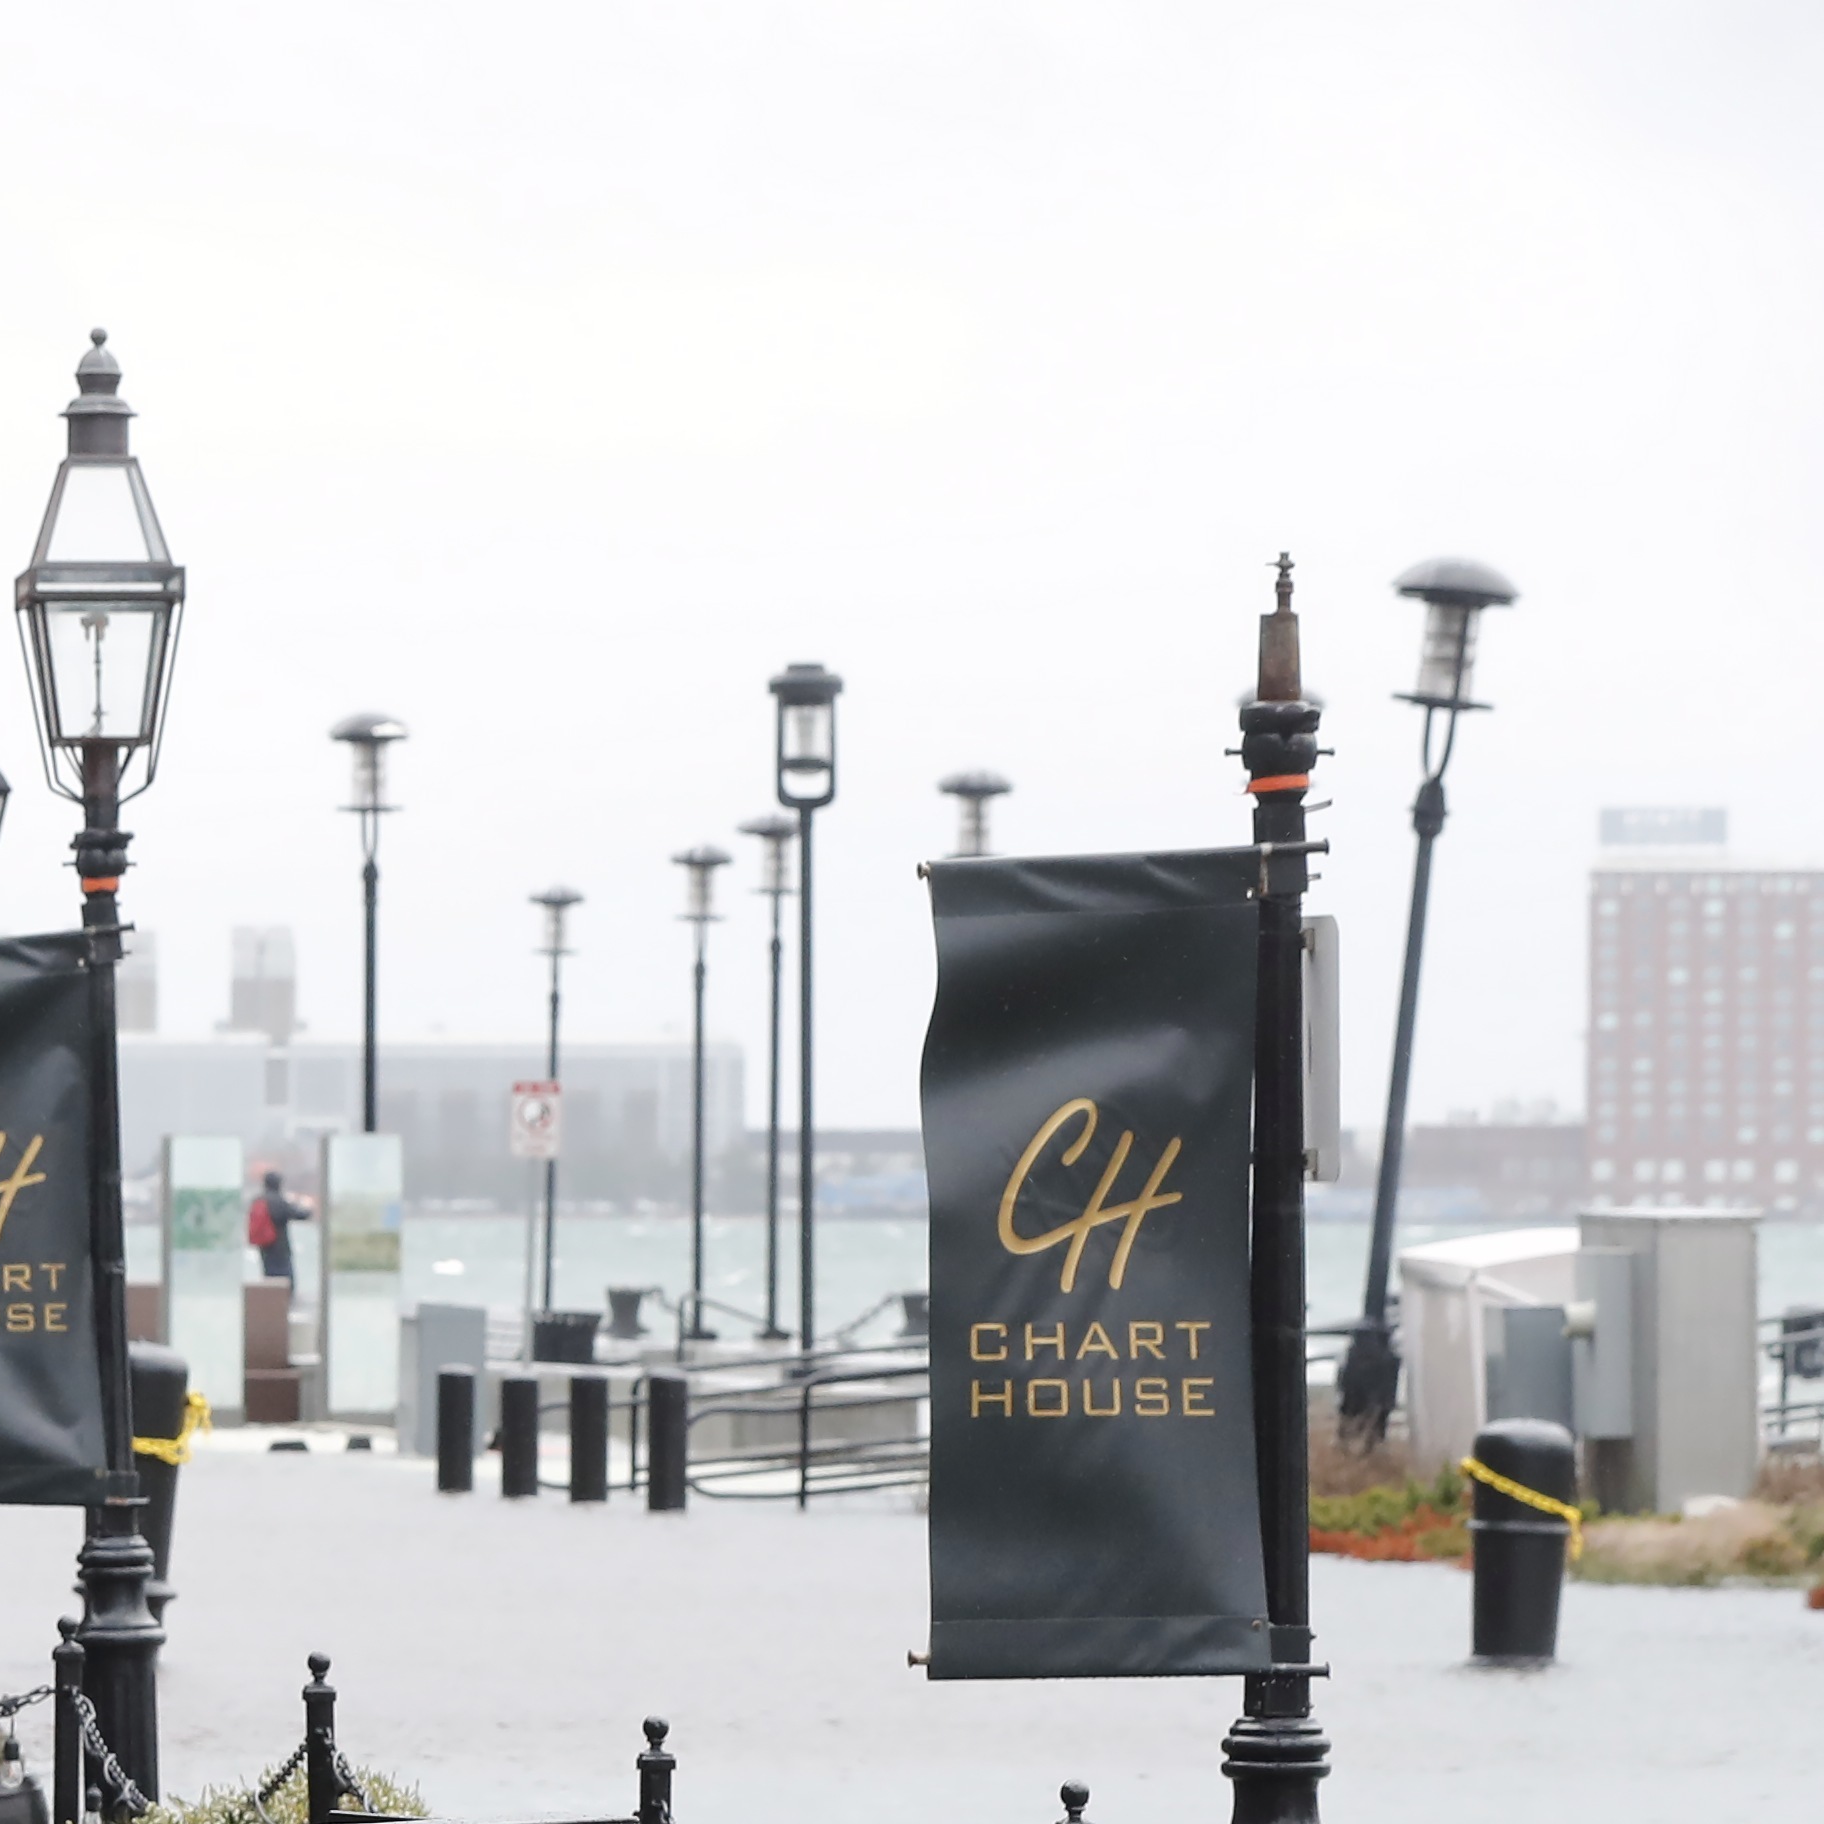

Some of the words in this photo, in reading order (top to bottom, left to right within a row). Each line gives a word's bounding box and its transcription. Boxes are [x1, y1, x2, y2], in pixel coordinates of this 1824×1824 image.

[997, 1097, 1183, 1294] CH
[969, 1320, 1212, 1361] CHART
[970, 1376, 1216, 1418] HOUSE
